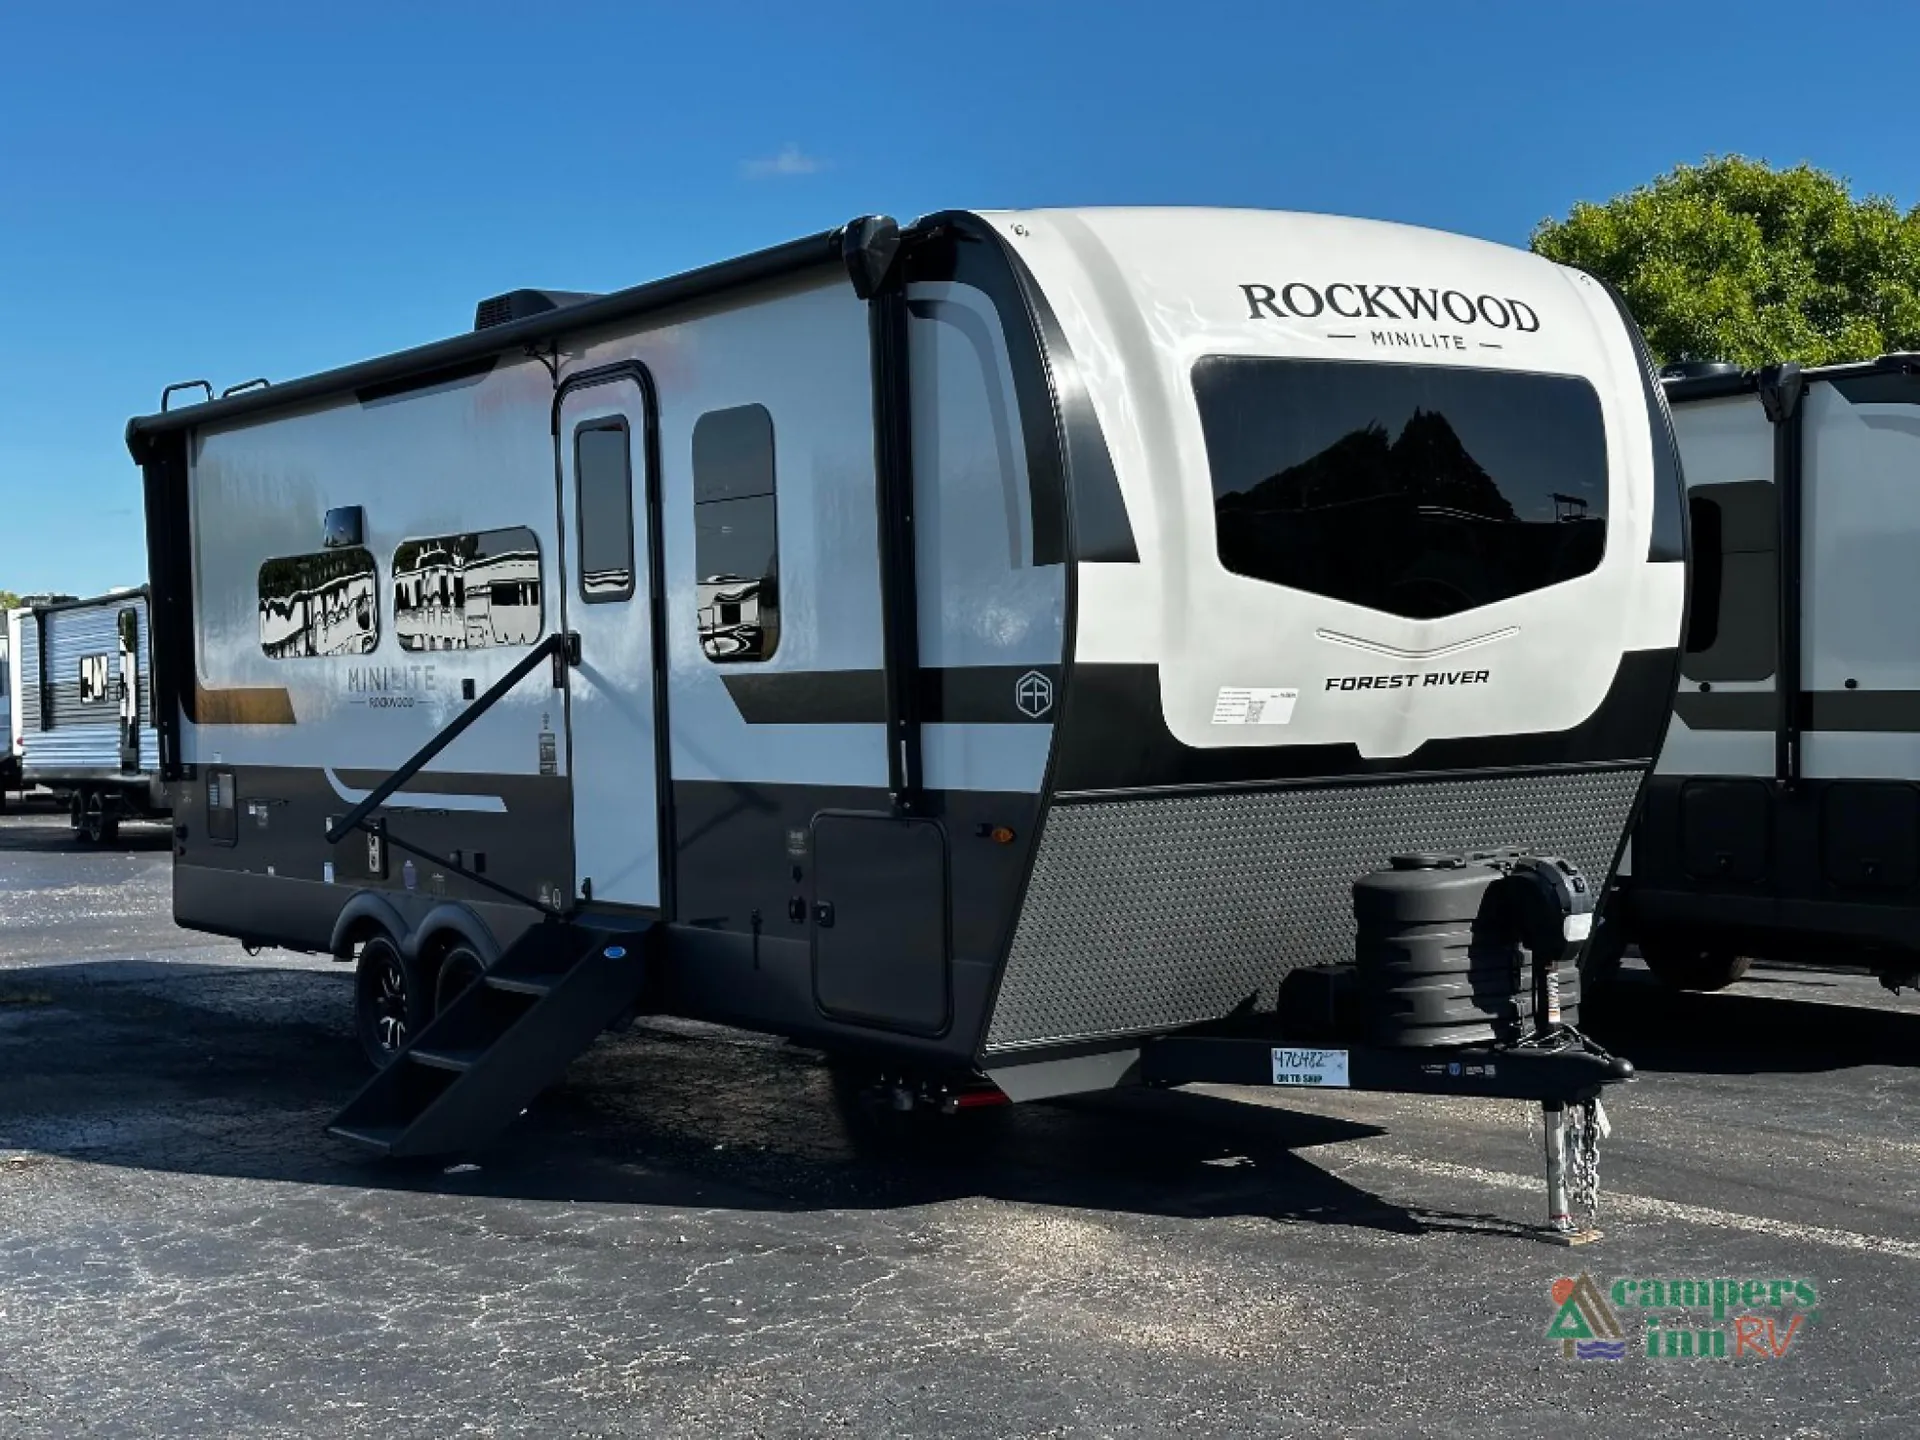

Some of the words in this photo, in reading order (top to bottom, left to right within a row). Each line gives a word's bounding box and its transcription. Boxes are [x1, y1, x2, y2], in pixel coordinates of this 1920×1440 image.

[1239, 282, 1540, 333] ROCKWOOD
[1370, 330, 1466, 351] MINILITE
[348, 664, 436, 693] MINILITE
[1325, 674, 1419, 691] FOREST
[1423, 670, 1490, 687] RIVER
[369, 697, 415, 709] ROCKWOOD
